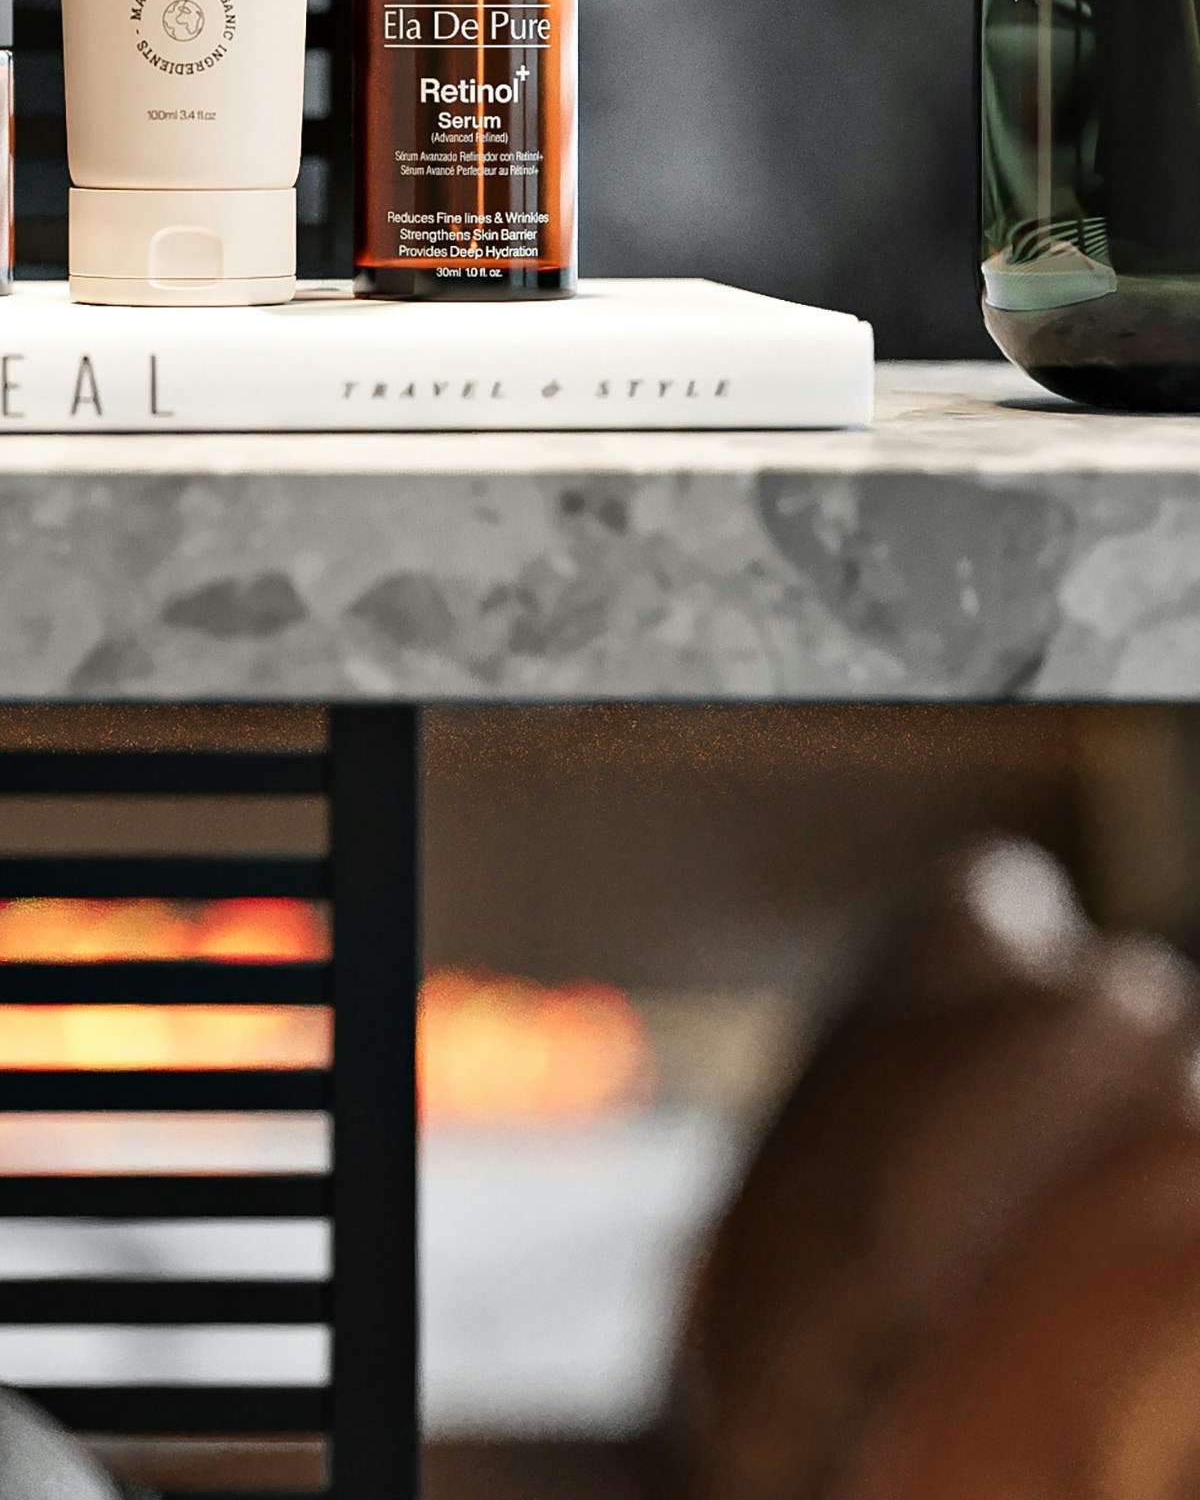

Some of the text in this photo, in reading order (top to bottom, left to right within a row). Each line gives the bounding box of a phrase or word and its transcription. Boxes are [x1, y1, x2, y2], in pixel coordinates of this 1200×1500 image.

[383, 8, 552, 41] Ela De Pure
[136, 39, 228, 75] INGREDIENTS
[147, 109, 178, 120] 100ml
[437, 112, 502, 130] Serum
[430, 131, 509, 145] (Advanced Refined)
[420, 150, 458, 162] Avanzado
[499, 152, 514, 162] con
[456, 164, 497, 176] Perfeceur
[498, 167, 509, 176] au
[387, 211, 549, 224] Reduces Fine lines & Wrinkles
[399, 228, 538, 243] Strengthens Skin Barrier
[398, 244, 539, 260] Provides Deep Hydration
[435, 266, 462, 278] 30ml
[341, 380, 506, 399] TRAVEL
[594, 378, 731, 399] STYLE
